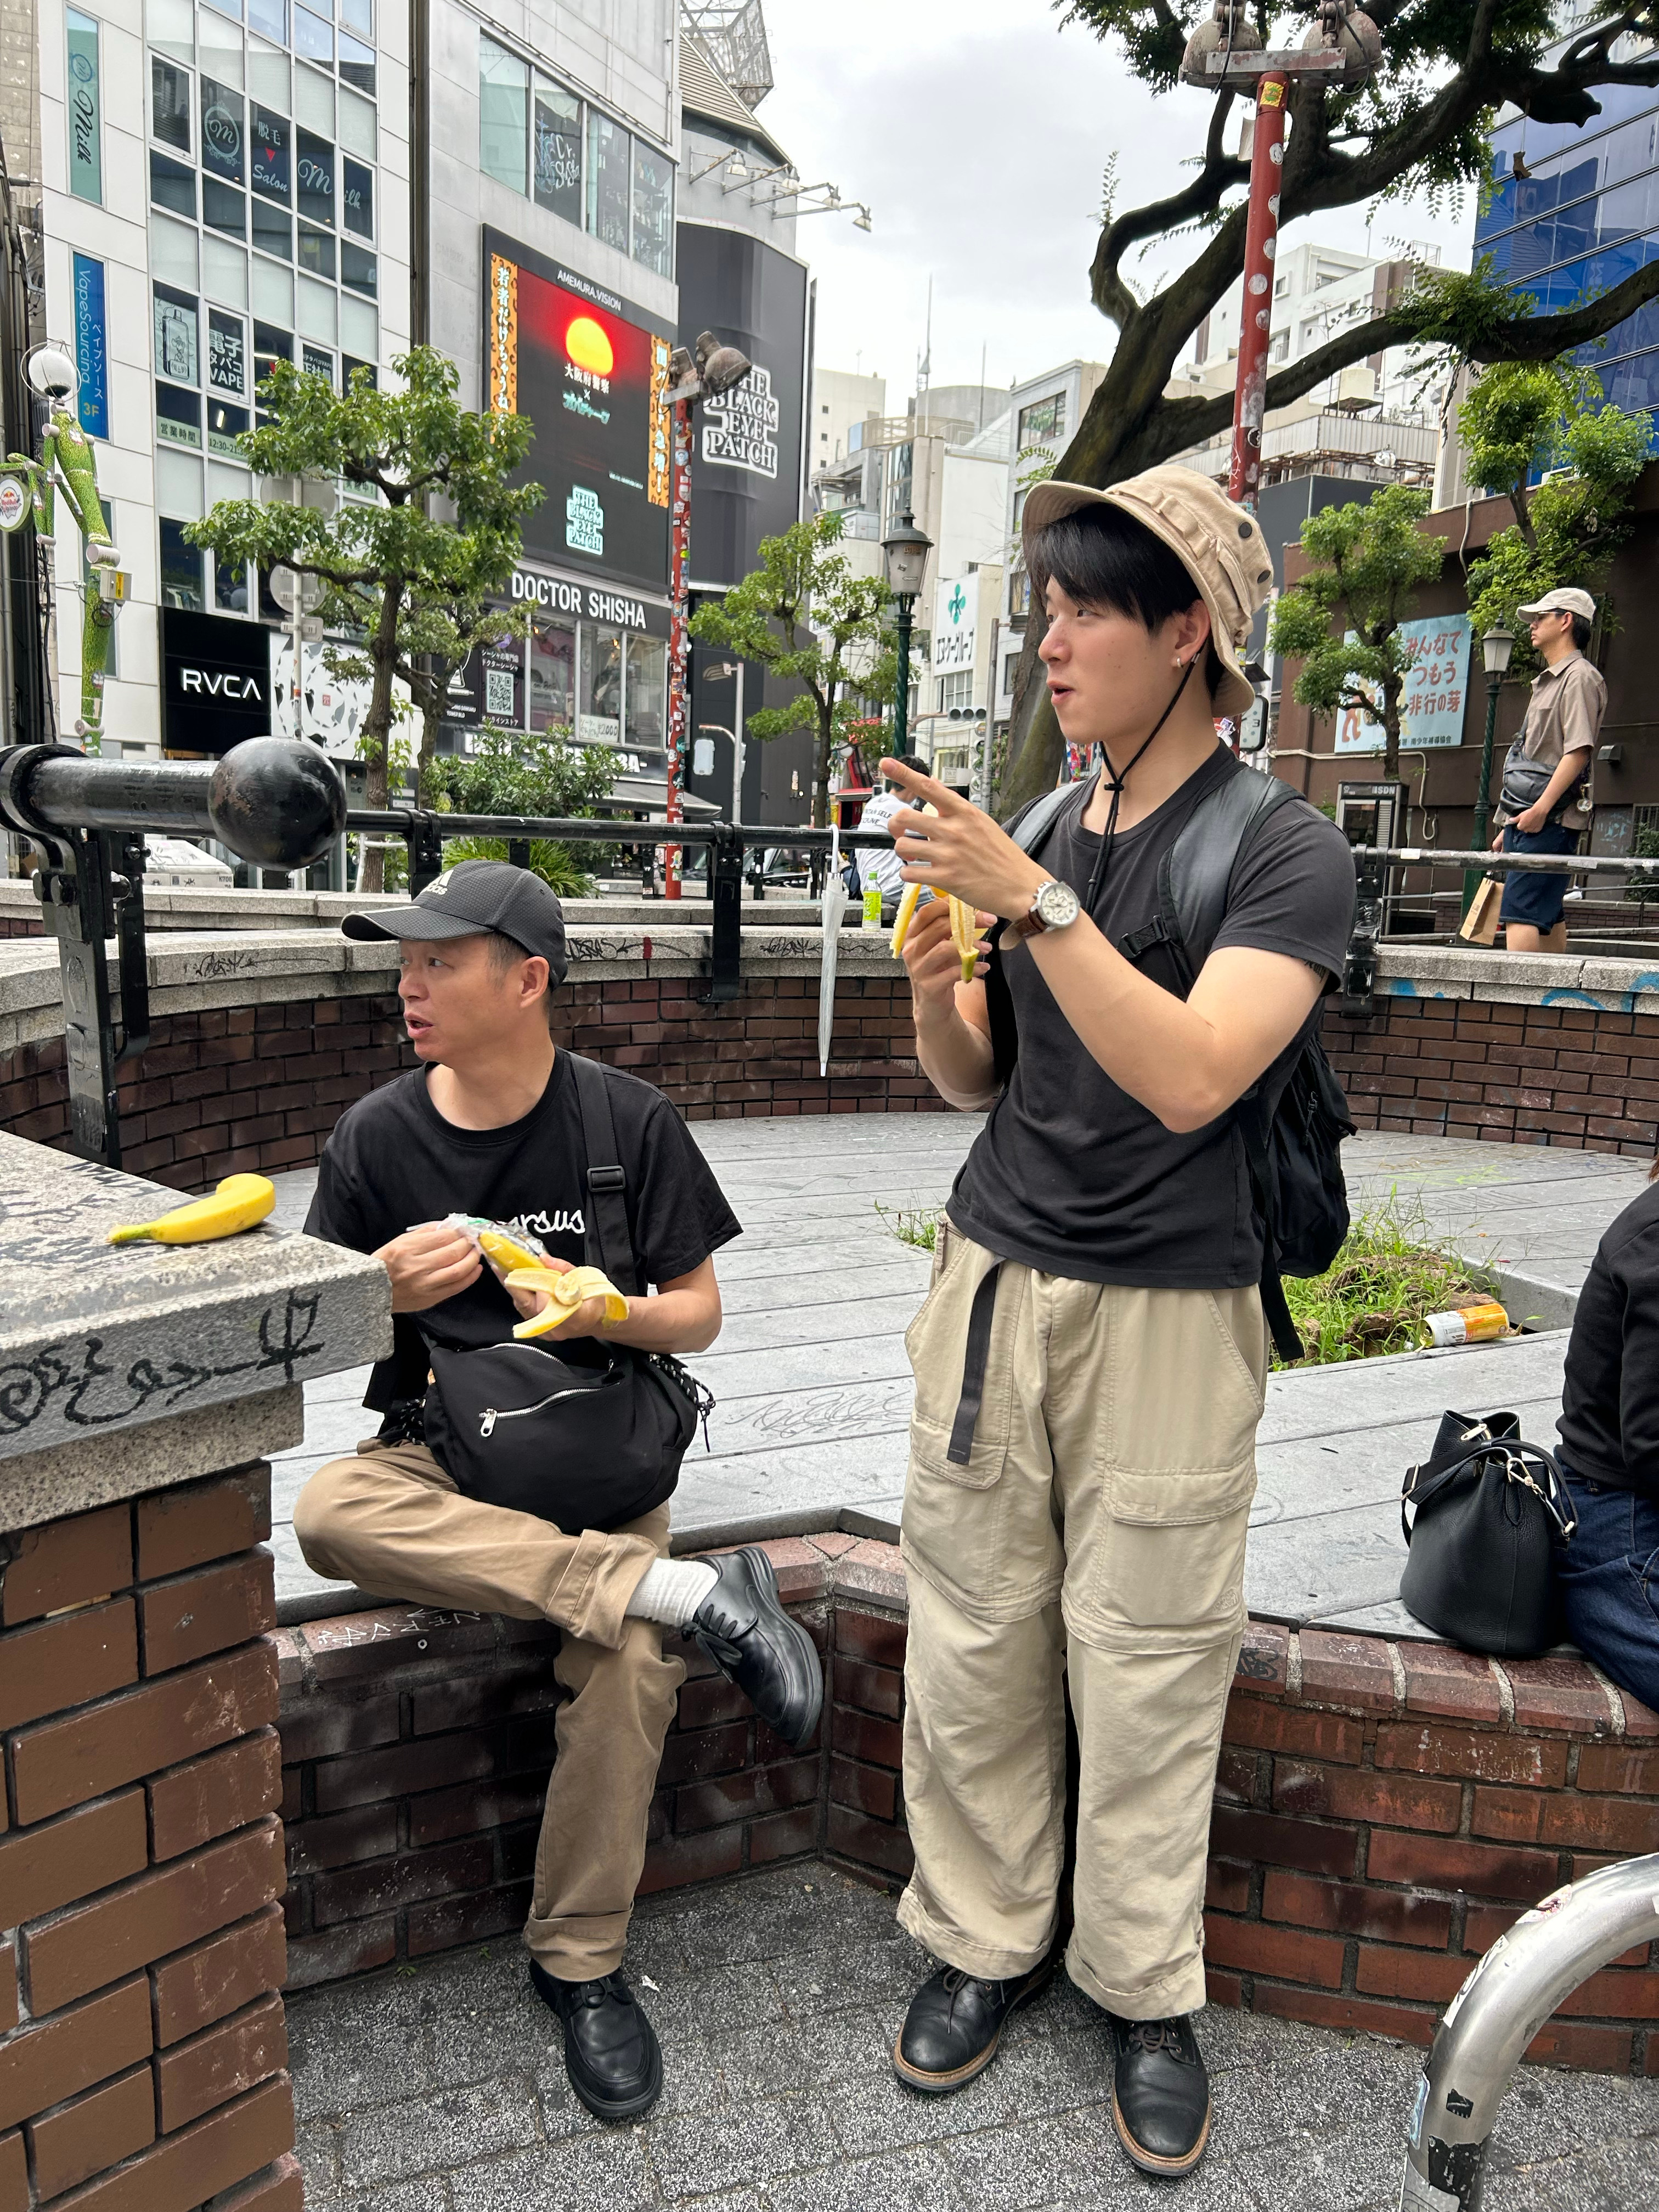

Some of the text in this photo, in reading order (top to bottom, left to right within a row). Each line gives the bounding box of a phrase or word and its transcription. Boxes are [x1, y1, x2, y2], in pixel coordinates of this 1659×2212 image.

[258, 121, 281, 146] 脱毛
[252, 164, 288, 193] Salon
[209, 329, 242, 358] 電子
[210, 350, 242, 375] タバコ
[210, 368, 244, 390] VAPE
[83, 403, 99, 417] 3F
[709, 388, 774, 423] BLACK
[161, 423, 196, 443] 営業時間
[727, 411, 763, 441] EYE
[708, 432, 773, 469] PATCH
[575, 491, 595, 509] THE
[575, 518, 594, 534] EYE
[569, 528, 601, 551] PATCH
[512, 572, 646, 629] DOCTOR SHISHA
[1404, 630, 1464, 657] みんなで
[181, 667, 262, 701] RVCA
[1413, 661, 1456, 686] つもう
[1409, 690, 1462, 716] 非行の芽
[482, 715, 518, 726] オラインストア
